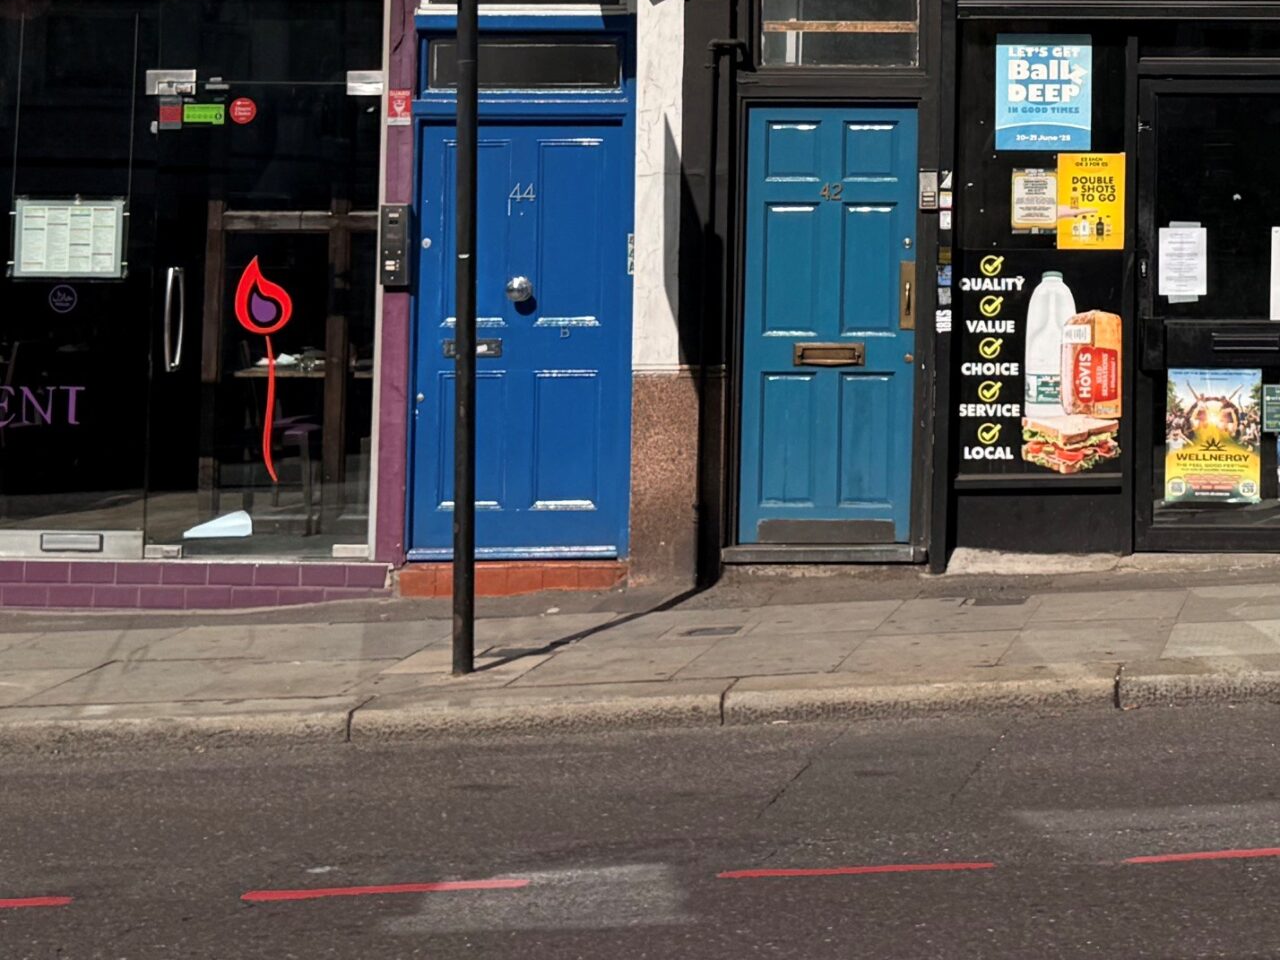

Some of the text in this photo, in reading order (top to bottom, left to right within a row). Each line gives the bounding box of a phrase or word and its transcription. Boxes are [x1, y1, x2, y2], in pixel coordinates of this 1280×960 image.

[1008, 46, 1080, 58] LET'S GET
[1007, 83, 1080, 103] DEEP
[1008, 106, 1080, 114] IN GOOD TIMES
[1038, 134, 1058, 142] June
[1072, 176, 1114, 185] DOUBLE
[508, 182, 536, 201] 44
[819, 182, 844, 201] 42
[1080, 184, 1116, 194] SHOTS
[1080, 193, 1116, 202] TO GO
[959, 276, 1025, 291] QUALITY
[966, 320, 1016, 334] VALUE
[961, 362, 1020, 376] CHOICE
[959, 403, 1021, 417] SERVICE
[963, 446, 1014, 460] LOCAL
[1176, 453, 1250, 462] WELLNERGY
